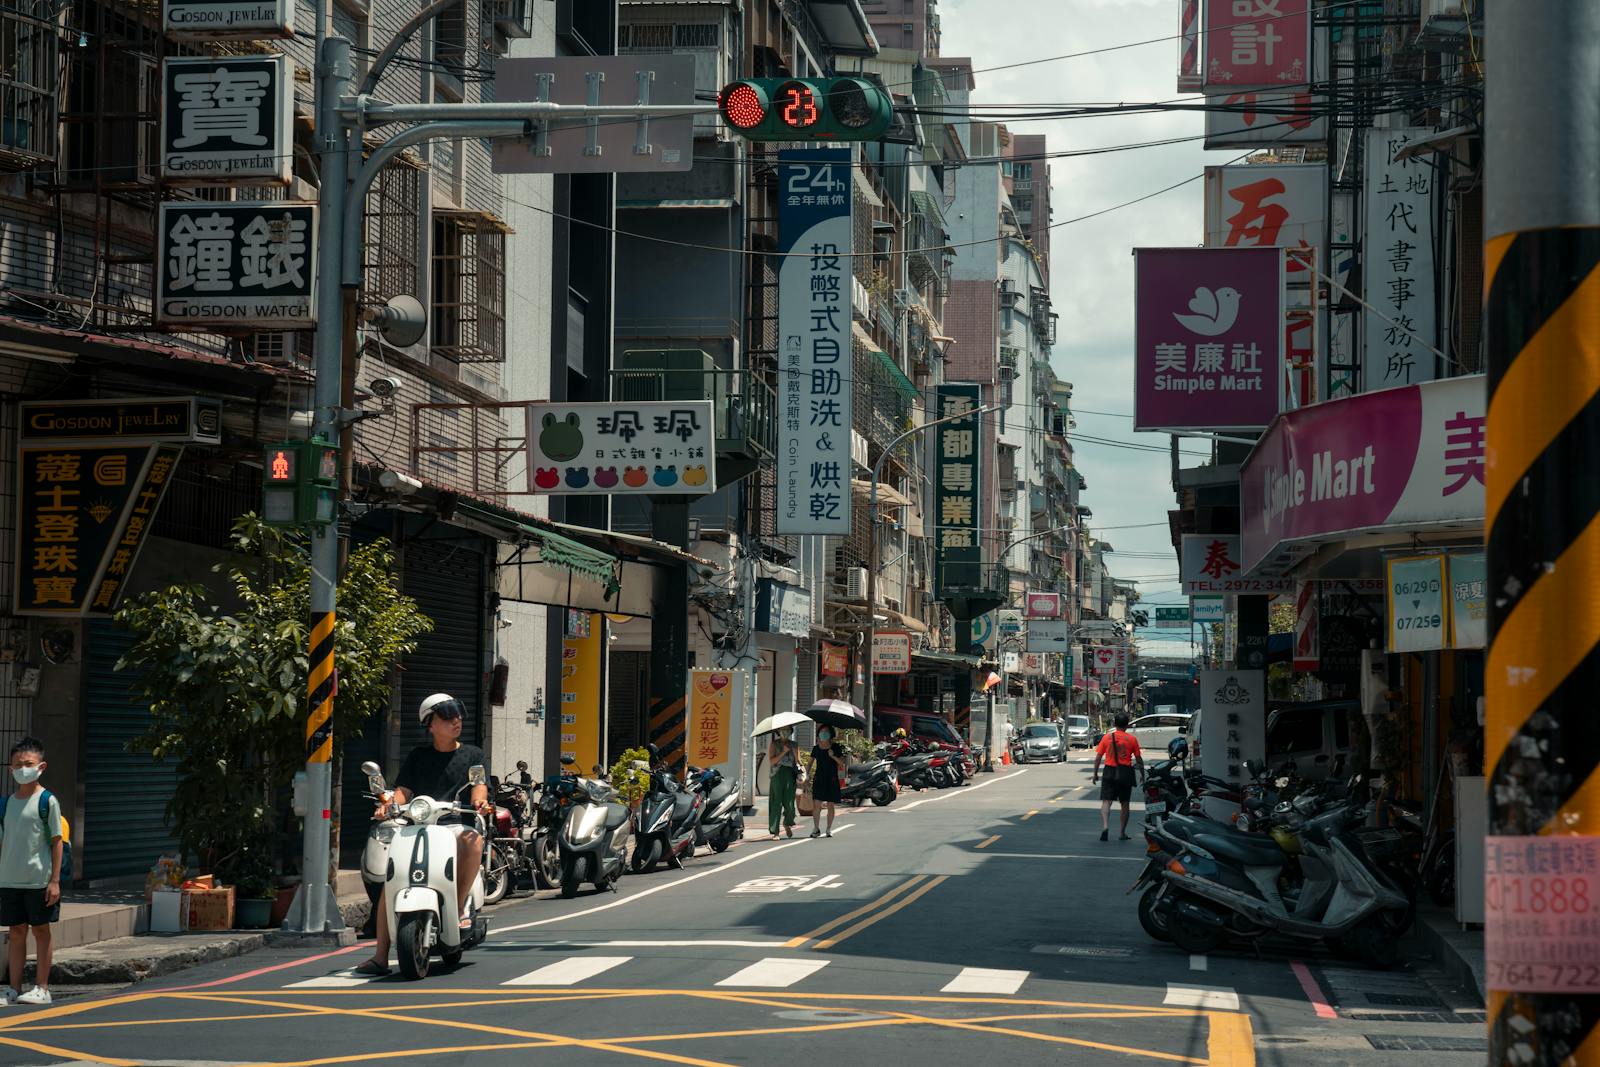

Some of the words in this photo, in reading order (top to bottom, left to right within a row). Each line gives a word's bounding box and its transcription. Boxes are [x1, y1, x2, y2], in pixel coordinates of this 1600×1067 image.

[172, 67, 271, 149] 寶
[784, 89, 817, 125] 23
[787, 163, 846, 193] 24h
[786, 194, 846, 206] 全年無休
[168, 211, 307, 291] 鐘錶
[255, 304, 310, 317] WATCH
[1154, 342, 1263, 373] 美廉社
[1154, 374, 1216, 394] Simple
[1220, 374, 1263, 391] Mart
[596, 410, 701, 443] 珮珮
[788, 438, 799, 466] Coin
[1311, 445, 1376, 502] Mart
[786, 471, 799, 519] Laundry
[1199, 538, 1241, 580] 泰
[1395, 581, 1428, 595] 06/29
[1397, 616, 1430, 630] 07/25
[699, 701, 720, 760] 公益彩券
